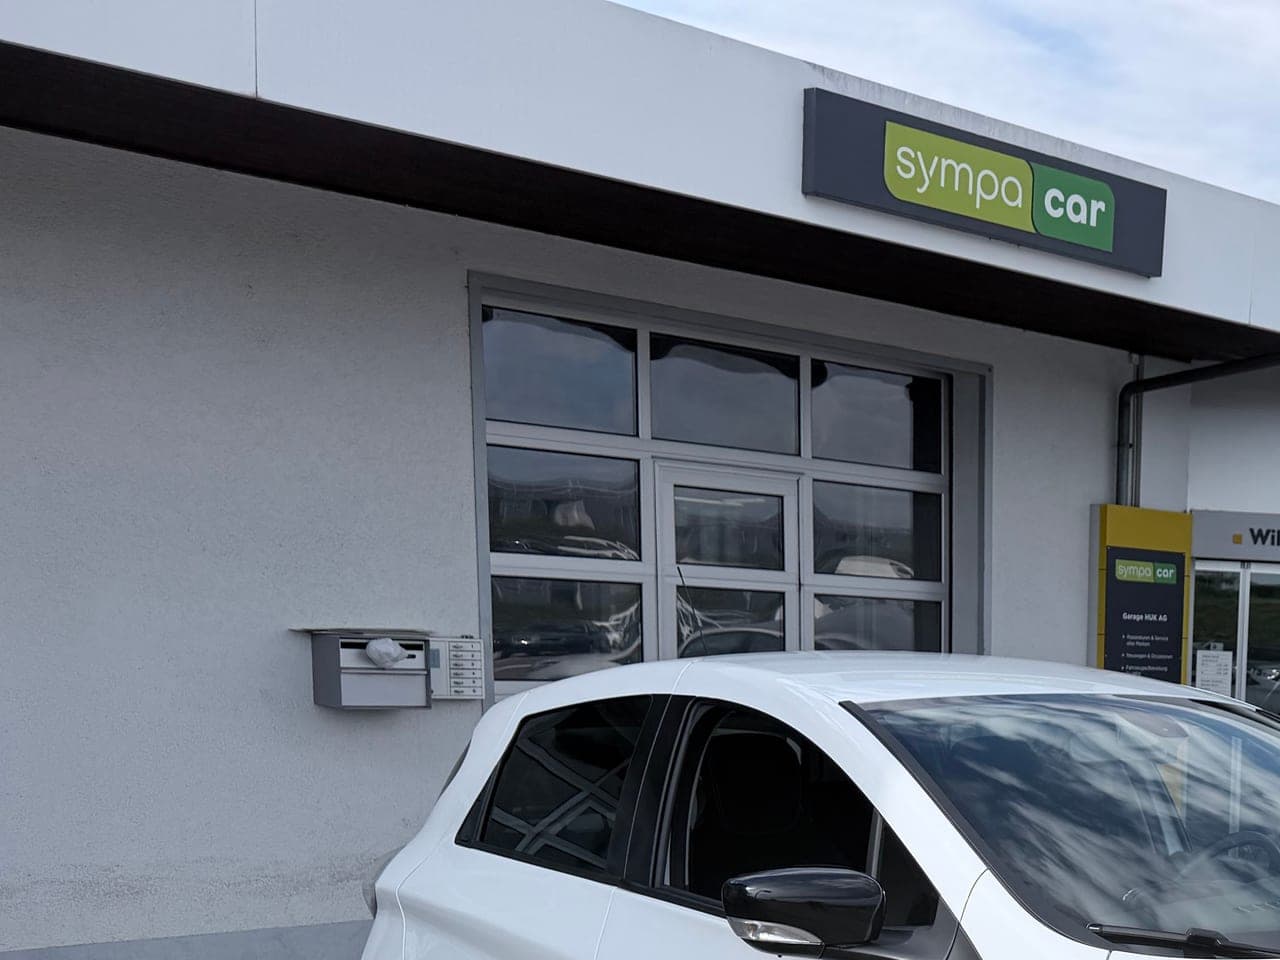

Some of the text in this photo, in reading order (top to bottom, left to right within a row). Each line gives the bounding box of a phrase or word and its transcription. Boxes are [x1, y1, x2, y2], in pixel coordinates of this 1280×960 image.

[896, 145, 1106, 228] sympa car
[1118, 565, 1174, 578] sympa car
[1122, 612, 1144, 622] Garage
[1158, 614, 1168, 622] AG
